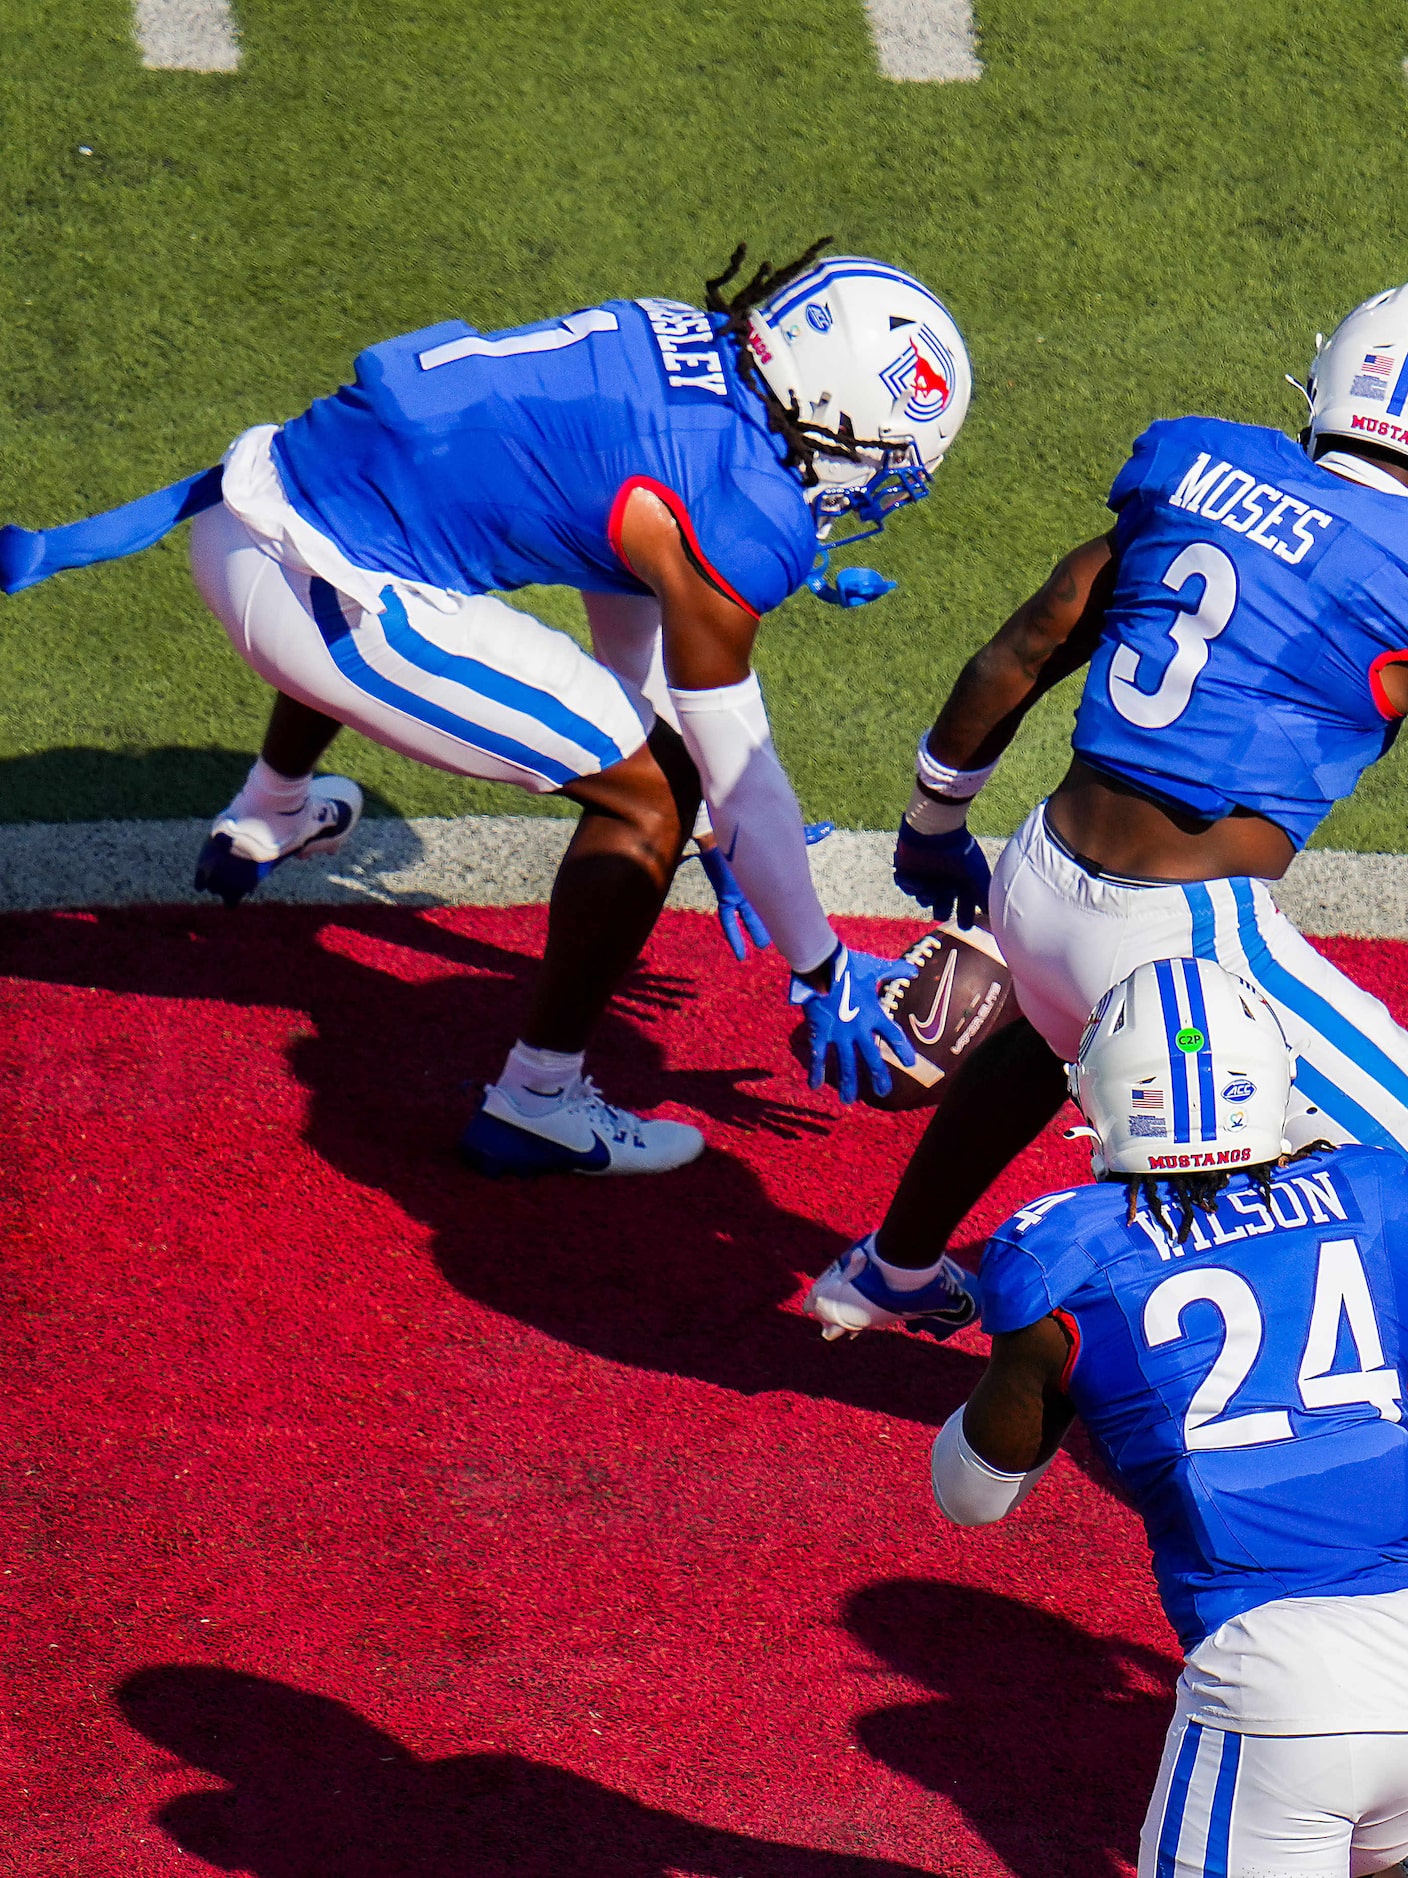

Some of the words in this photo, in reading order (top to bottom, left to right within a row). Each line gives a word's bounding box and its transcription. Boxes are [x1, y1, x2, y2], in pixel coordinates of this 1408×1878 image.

[419, 308, 618, 371] 1
[1168, 452, 1333, 565] MOSES
[1109, 542, 1237, 730] 3
[1178, 1035, 1201, 1046] C2P
[1225, 1086, 1253, 1100] ACC
[1148, 1148, 1252, 1170] MUSTANGS
[1133, 1170, 1348, 1261] WILSON
[1143, 1238, 1402, 1452] 24
